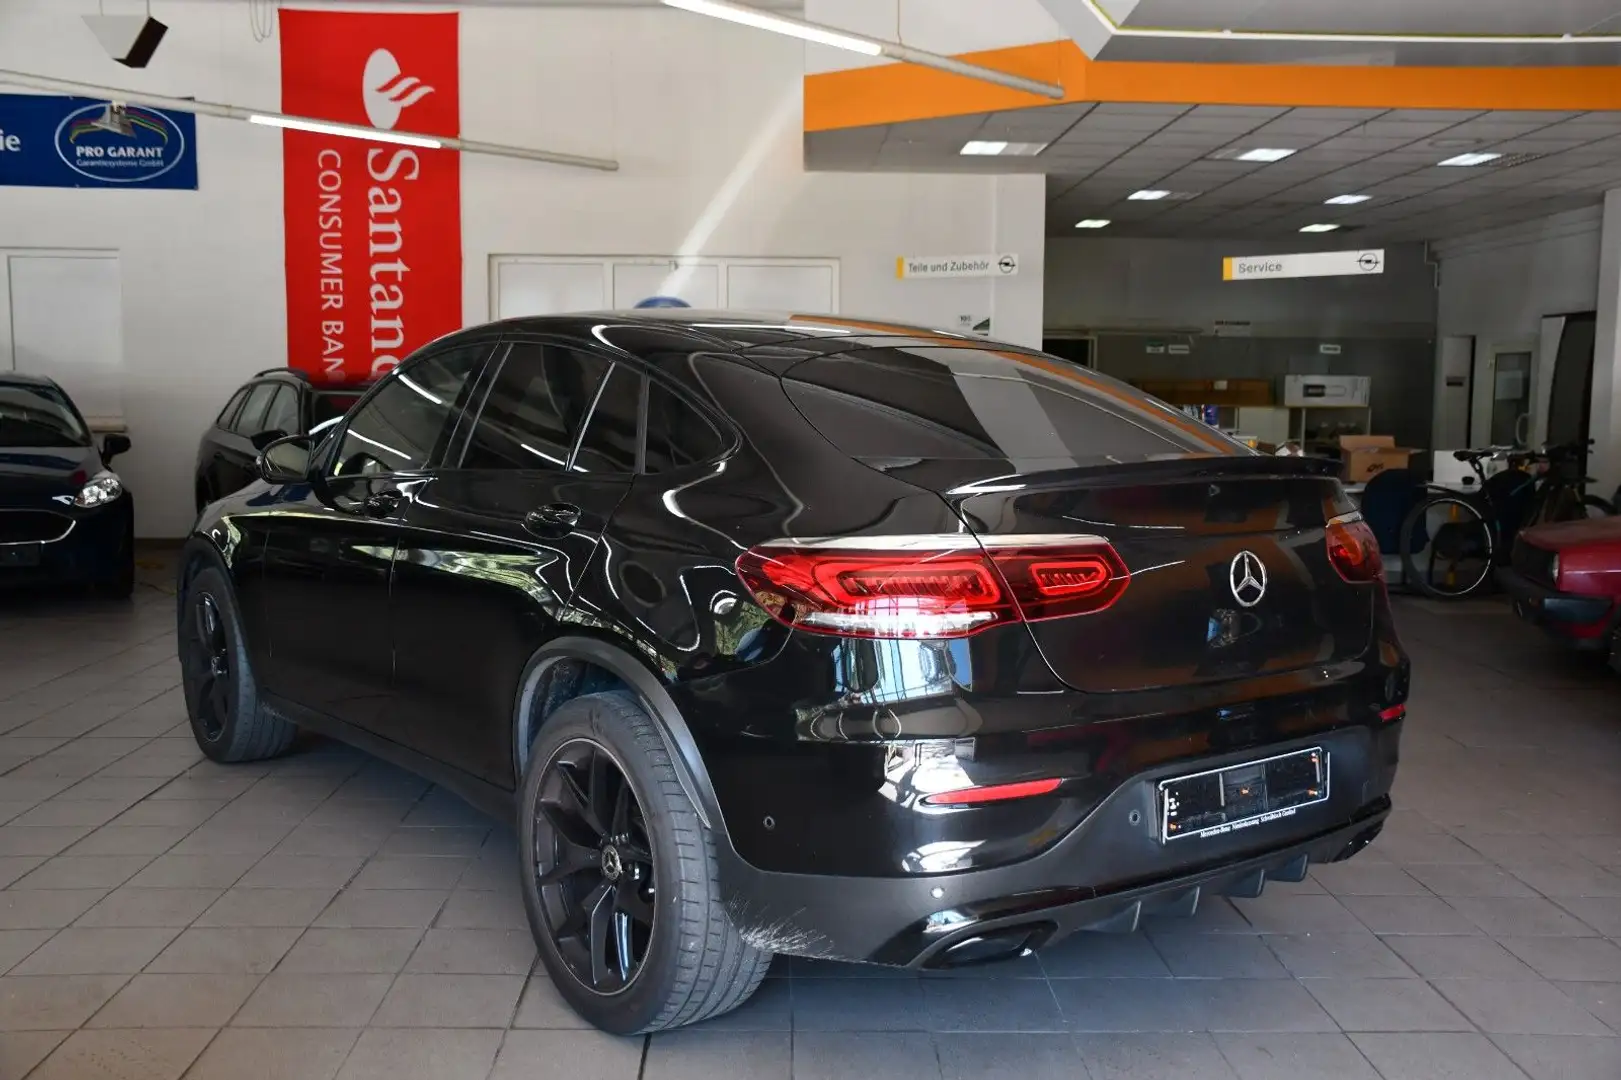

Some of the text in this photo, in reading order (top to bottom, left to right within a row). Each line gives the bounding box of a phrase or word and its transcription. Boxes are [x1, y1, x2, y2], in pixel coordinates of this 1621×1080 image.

[76, 146, 163, 157] PRO GARANT
[318, 149, 343, 311] CONSUMER
[908, 260, 989, 273] Teile und Zubehör
[1238, 262, 1282, 273] Service
